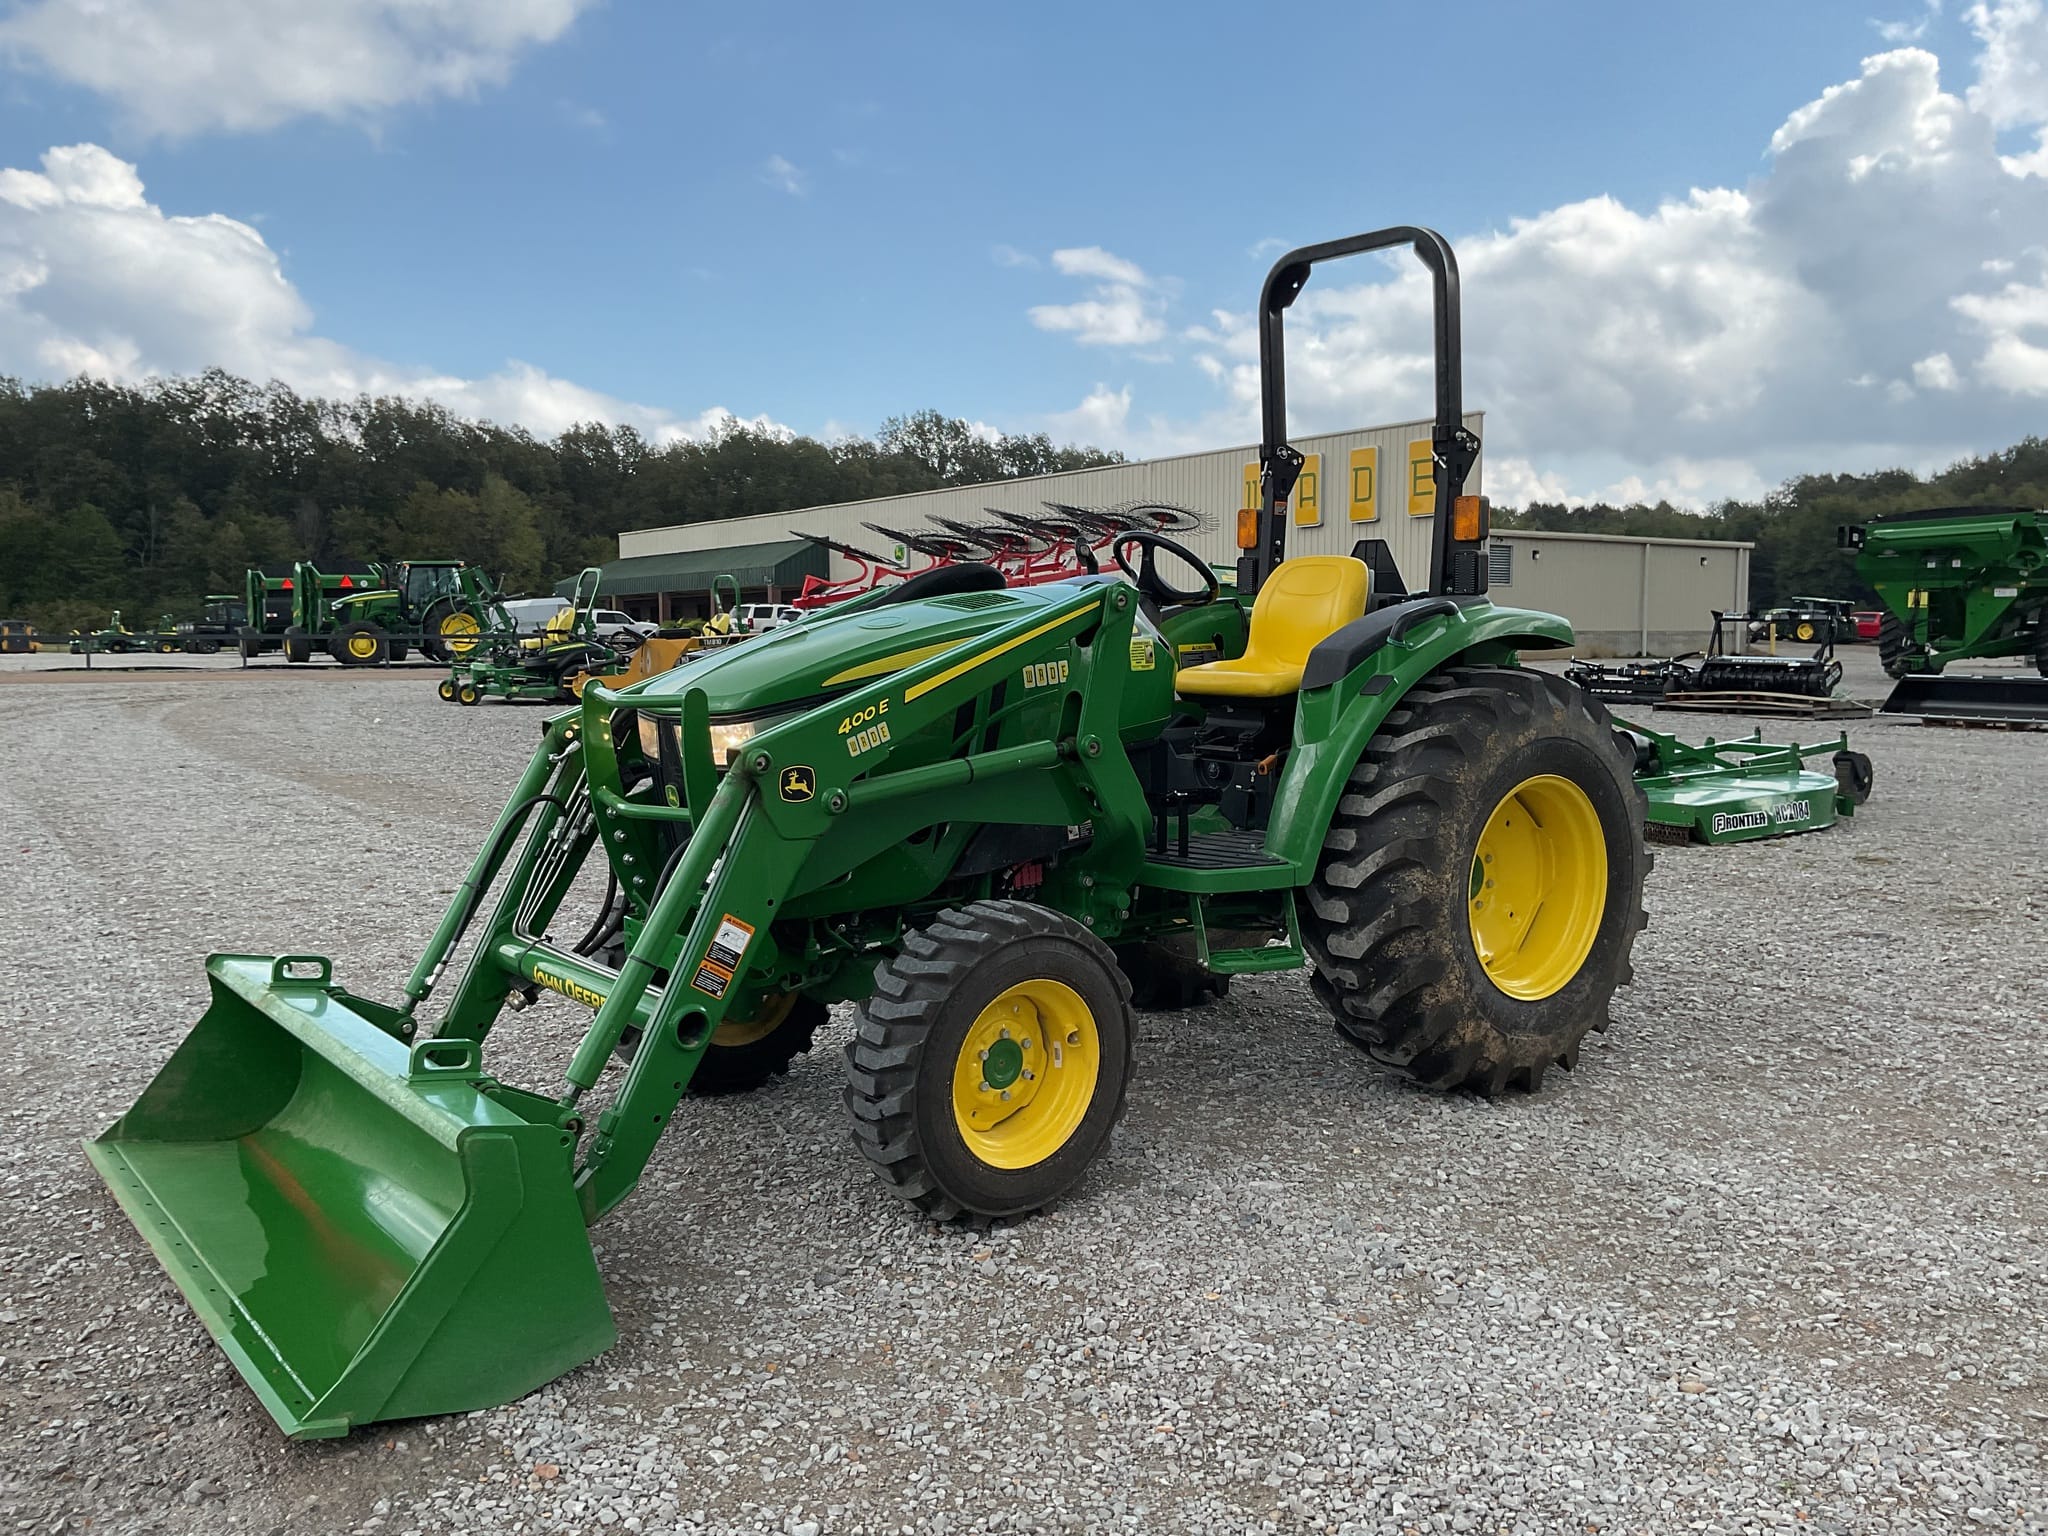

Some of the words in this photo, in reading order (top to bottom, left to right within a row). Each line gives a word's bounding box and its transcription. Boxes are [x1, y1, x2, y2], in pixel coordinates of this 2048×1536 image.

[838, 705, 876, 735] 400
[879, 698, 889, 714] E
[1713, 812, 1767, 834] FRONTIER
[533, 964, 564, 995] JOHN
